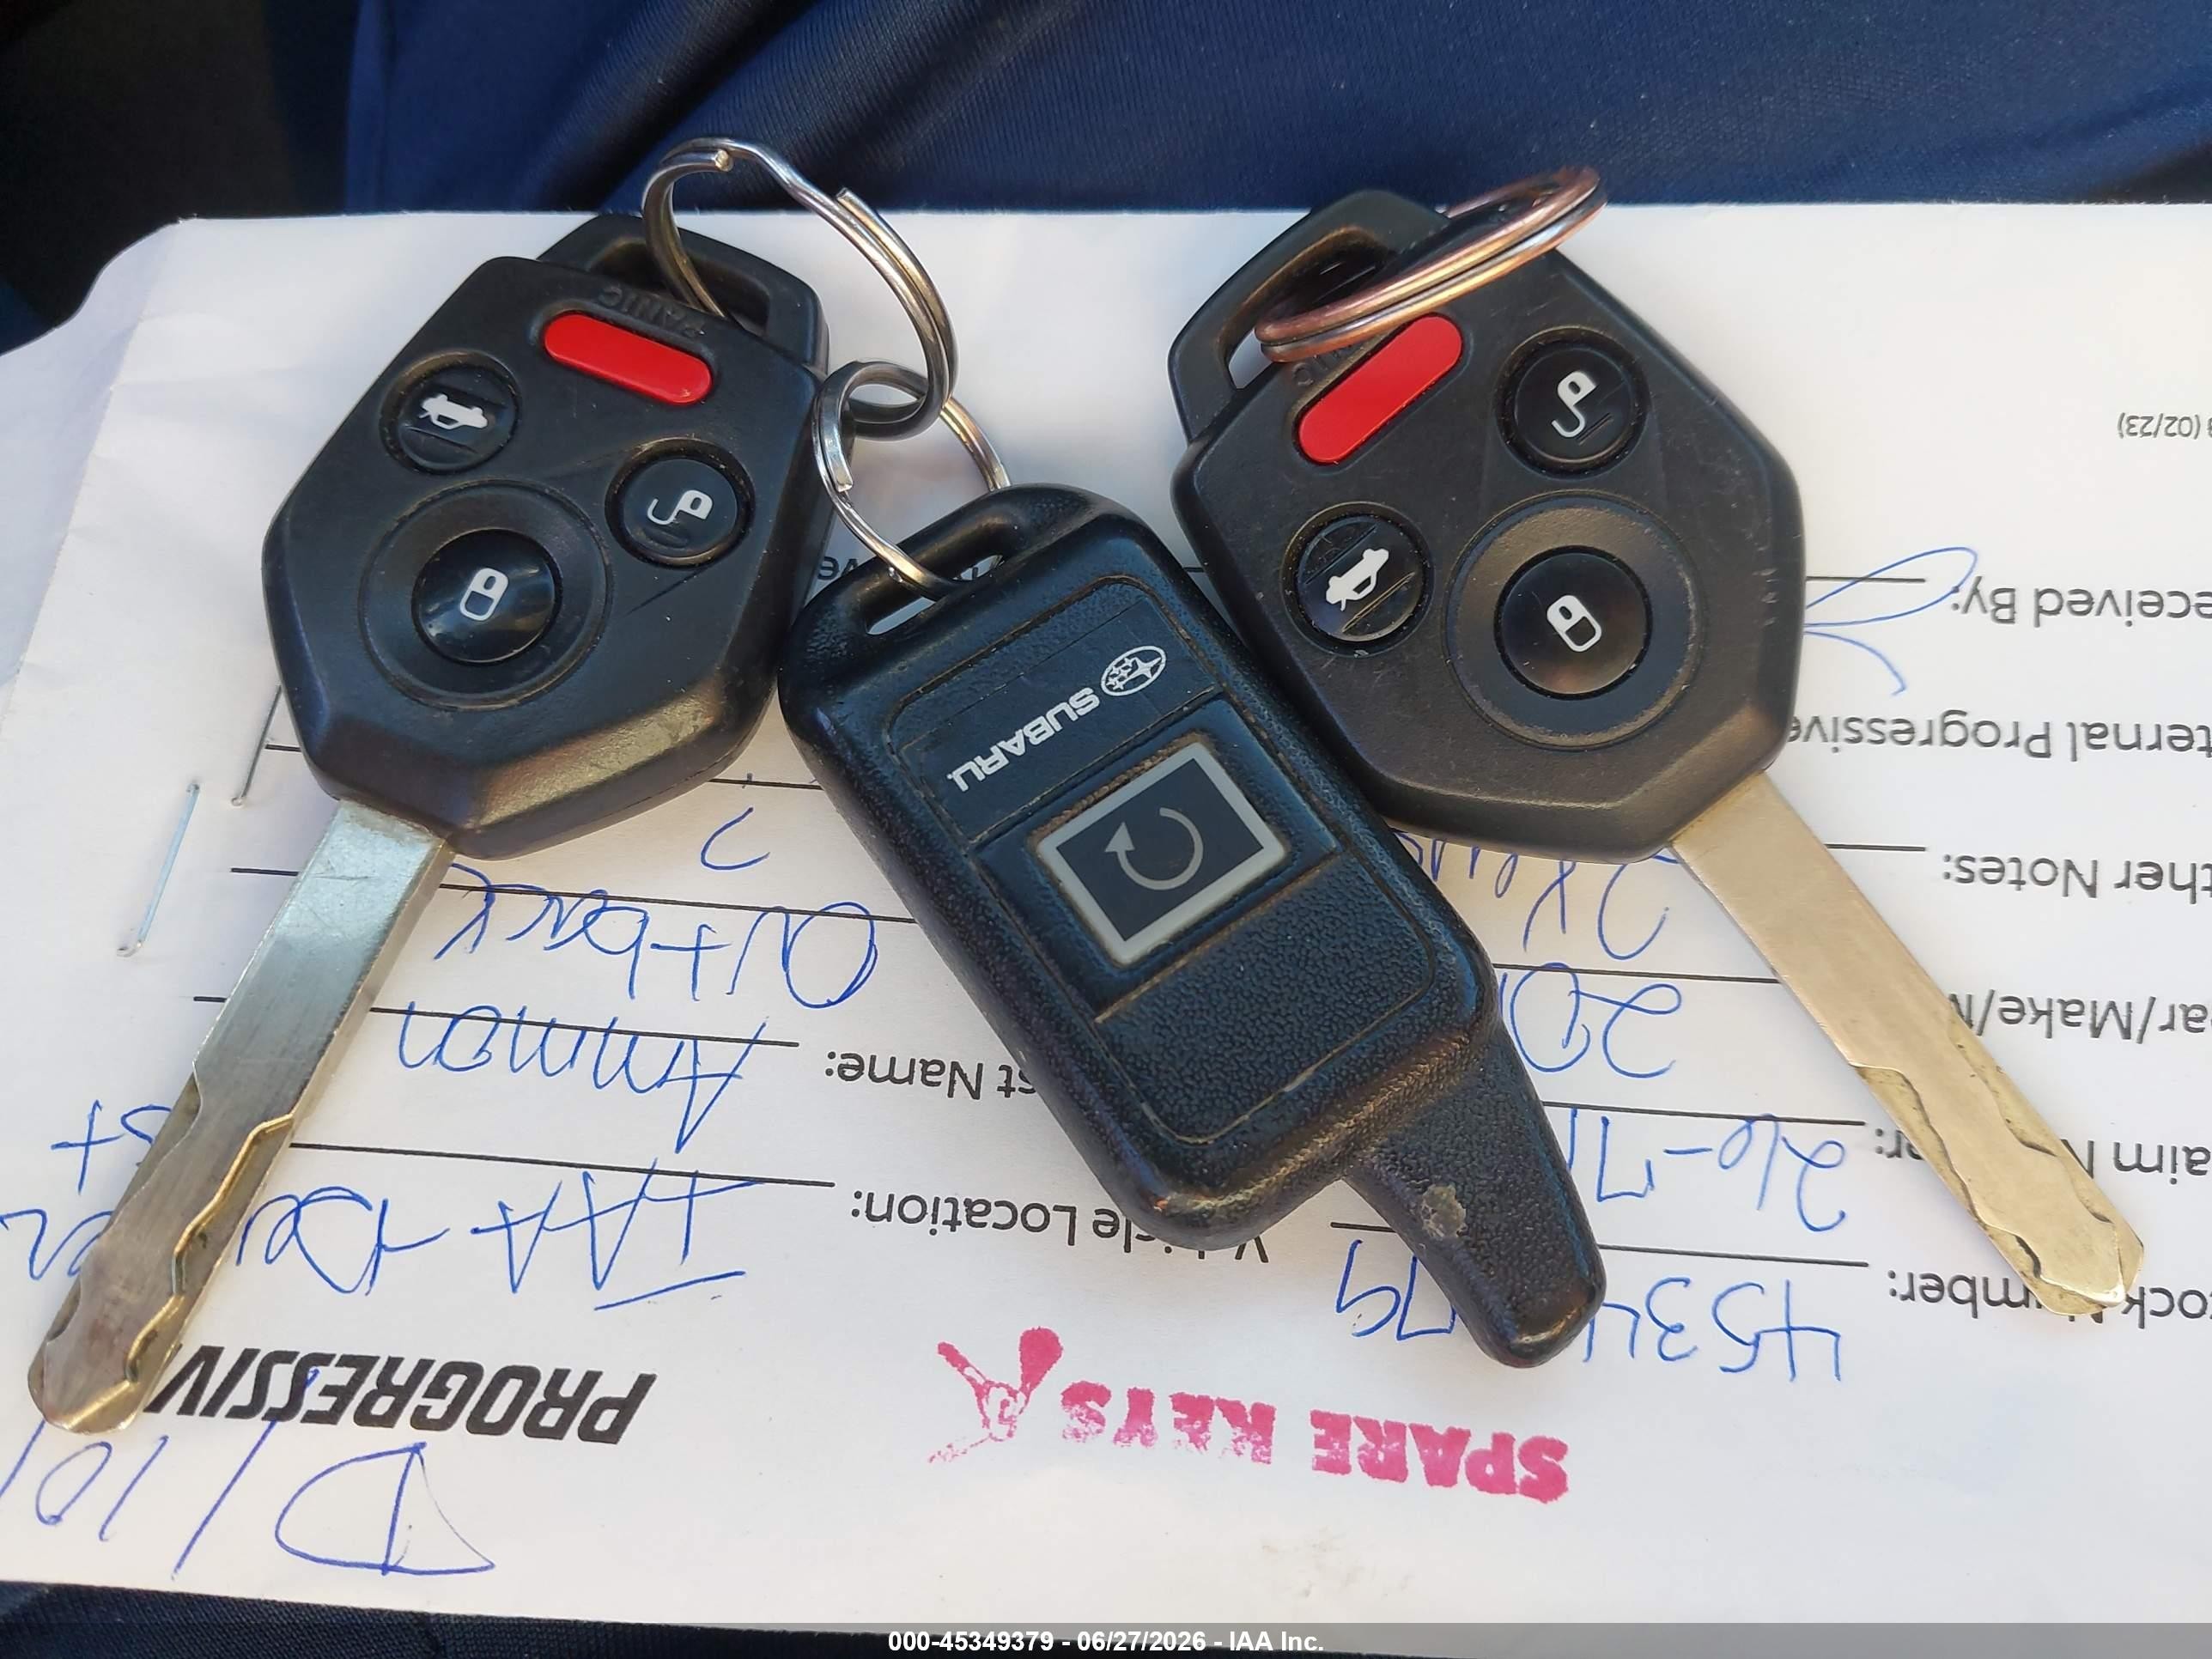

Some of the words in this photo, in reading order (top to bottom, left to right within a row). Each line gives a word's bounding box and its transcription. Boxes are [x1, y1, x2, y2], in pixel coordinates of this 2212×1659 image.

[2117, 412, 2201, 440] (02/23)
[947, 687, 1100, 792] SUBARU
[1942, 854, 2098, 898] Notes:
[1949, 988, 2212, 1044] ar/Make/
[825, 1050, 983, 1100] Name:
[852, 1191, 1075, 1245] Location:
[1335, 1239, 1843, 1382] 453479
[1887, 1270, 2104, 1324] mber:
[2121, 1285, 2212, 1329] ock
[143, 1344, 657, 1445] PROGRESSIV
[1060, 1381, 1278, 1465] KEYS
[1310, 1410, 1570, 1504] SPARE
